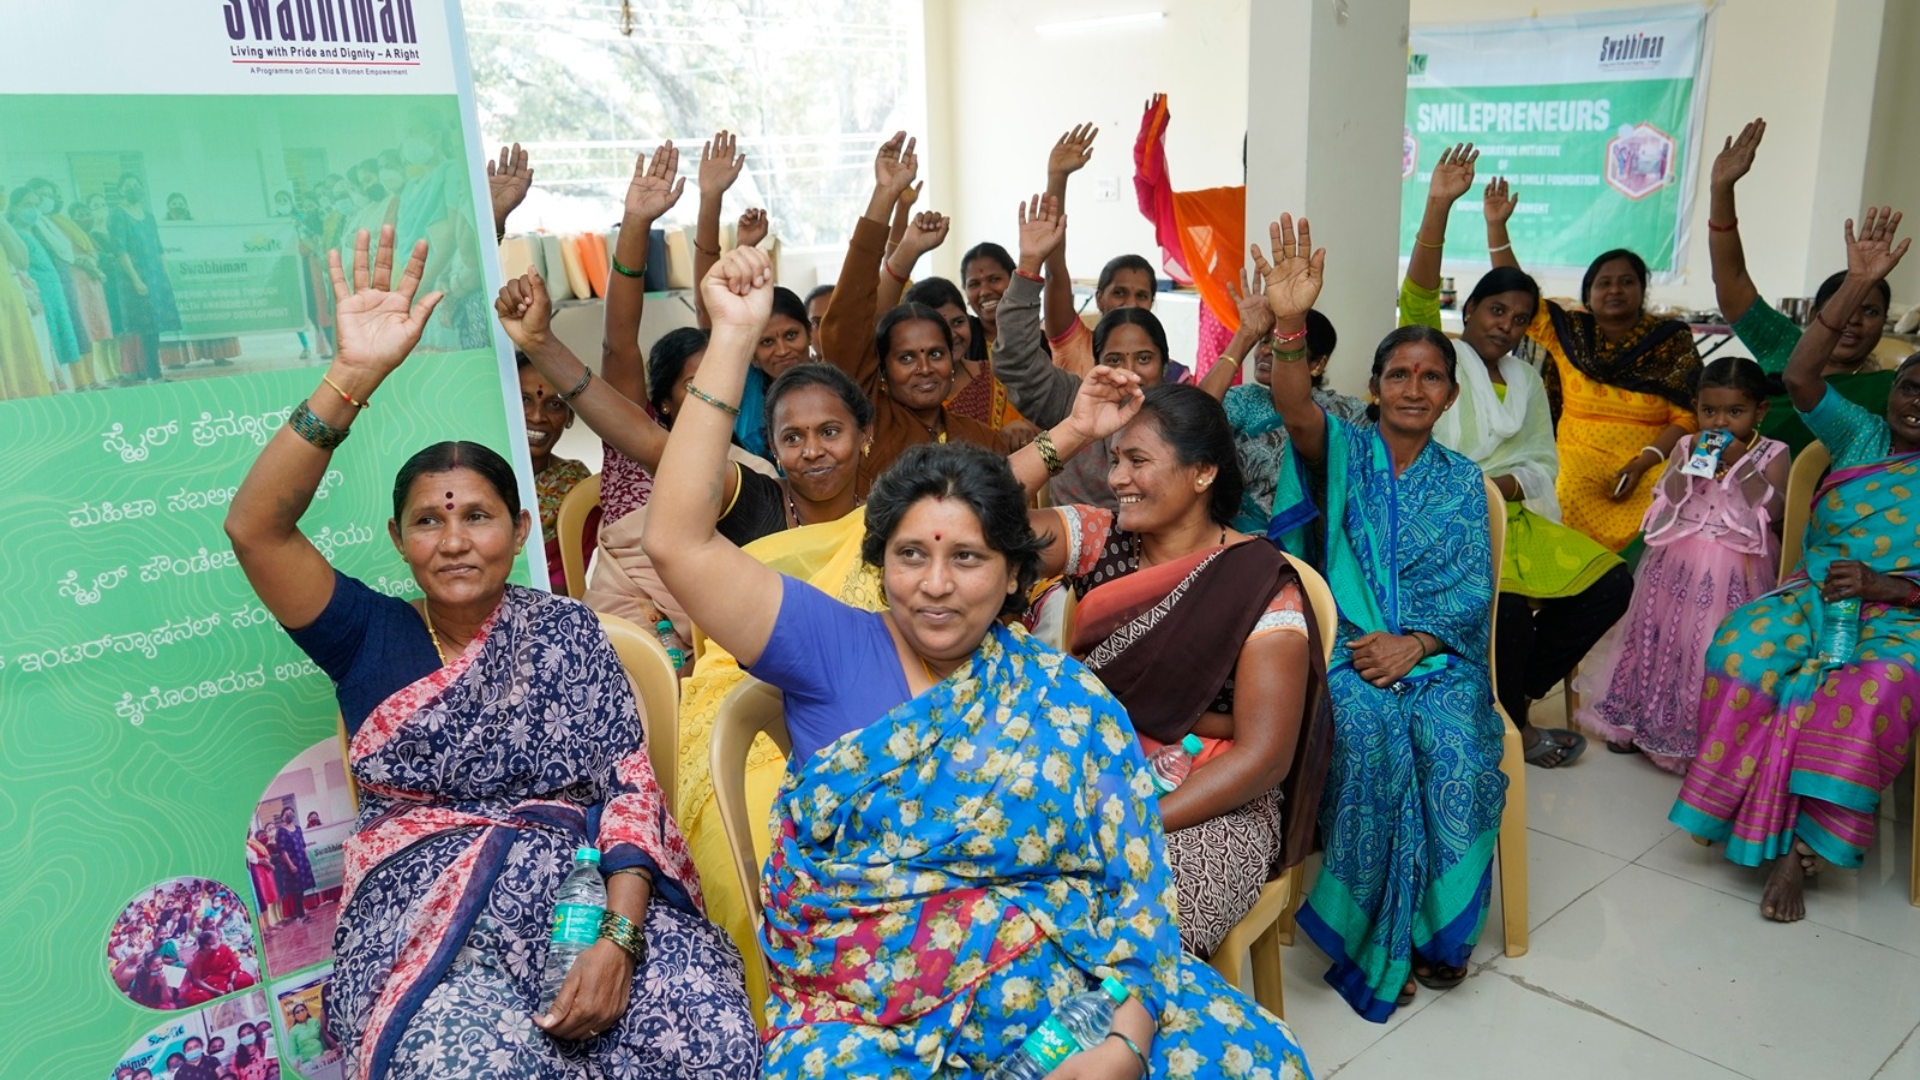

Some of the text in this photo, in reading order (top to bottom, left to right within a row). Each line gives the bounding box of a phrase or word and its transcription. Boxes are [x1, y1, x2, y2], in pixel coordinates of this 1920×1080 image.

[230, 45, 264, 59] Living
[266, 46, 288, 57] with
[290, 46, 317, 57] Pride
[320, 47, 338, 58] and
[340, 47, 375, 60] Dignity
[385, 48, 392, 58] A
[394, 48, 420, 61] Right
[1599, 33, 1664, 62] Swabhiman
[257, 67, 294, 76] Programme
[304, 67, 317, 75] Girl
[318, 67, 334, 75] Child
[365, 68, 408, 76] Empowerment
[1416, 99, 1611, 133] SMILEPRENEURS
[179, 261, 248, 276] Swabhiman
[68, 498, 157, 529] ಮಹಿಳಾ
